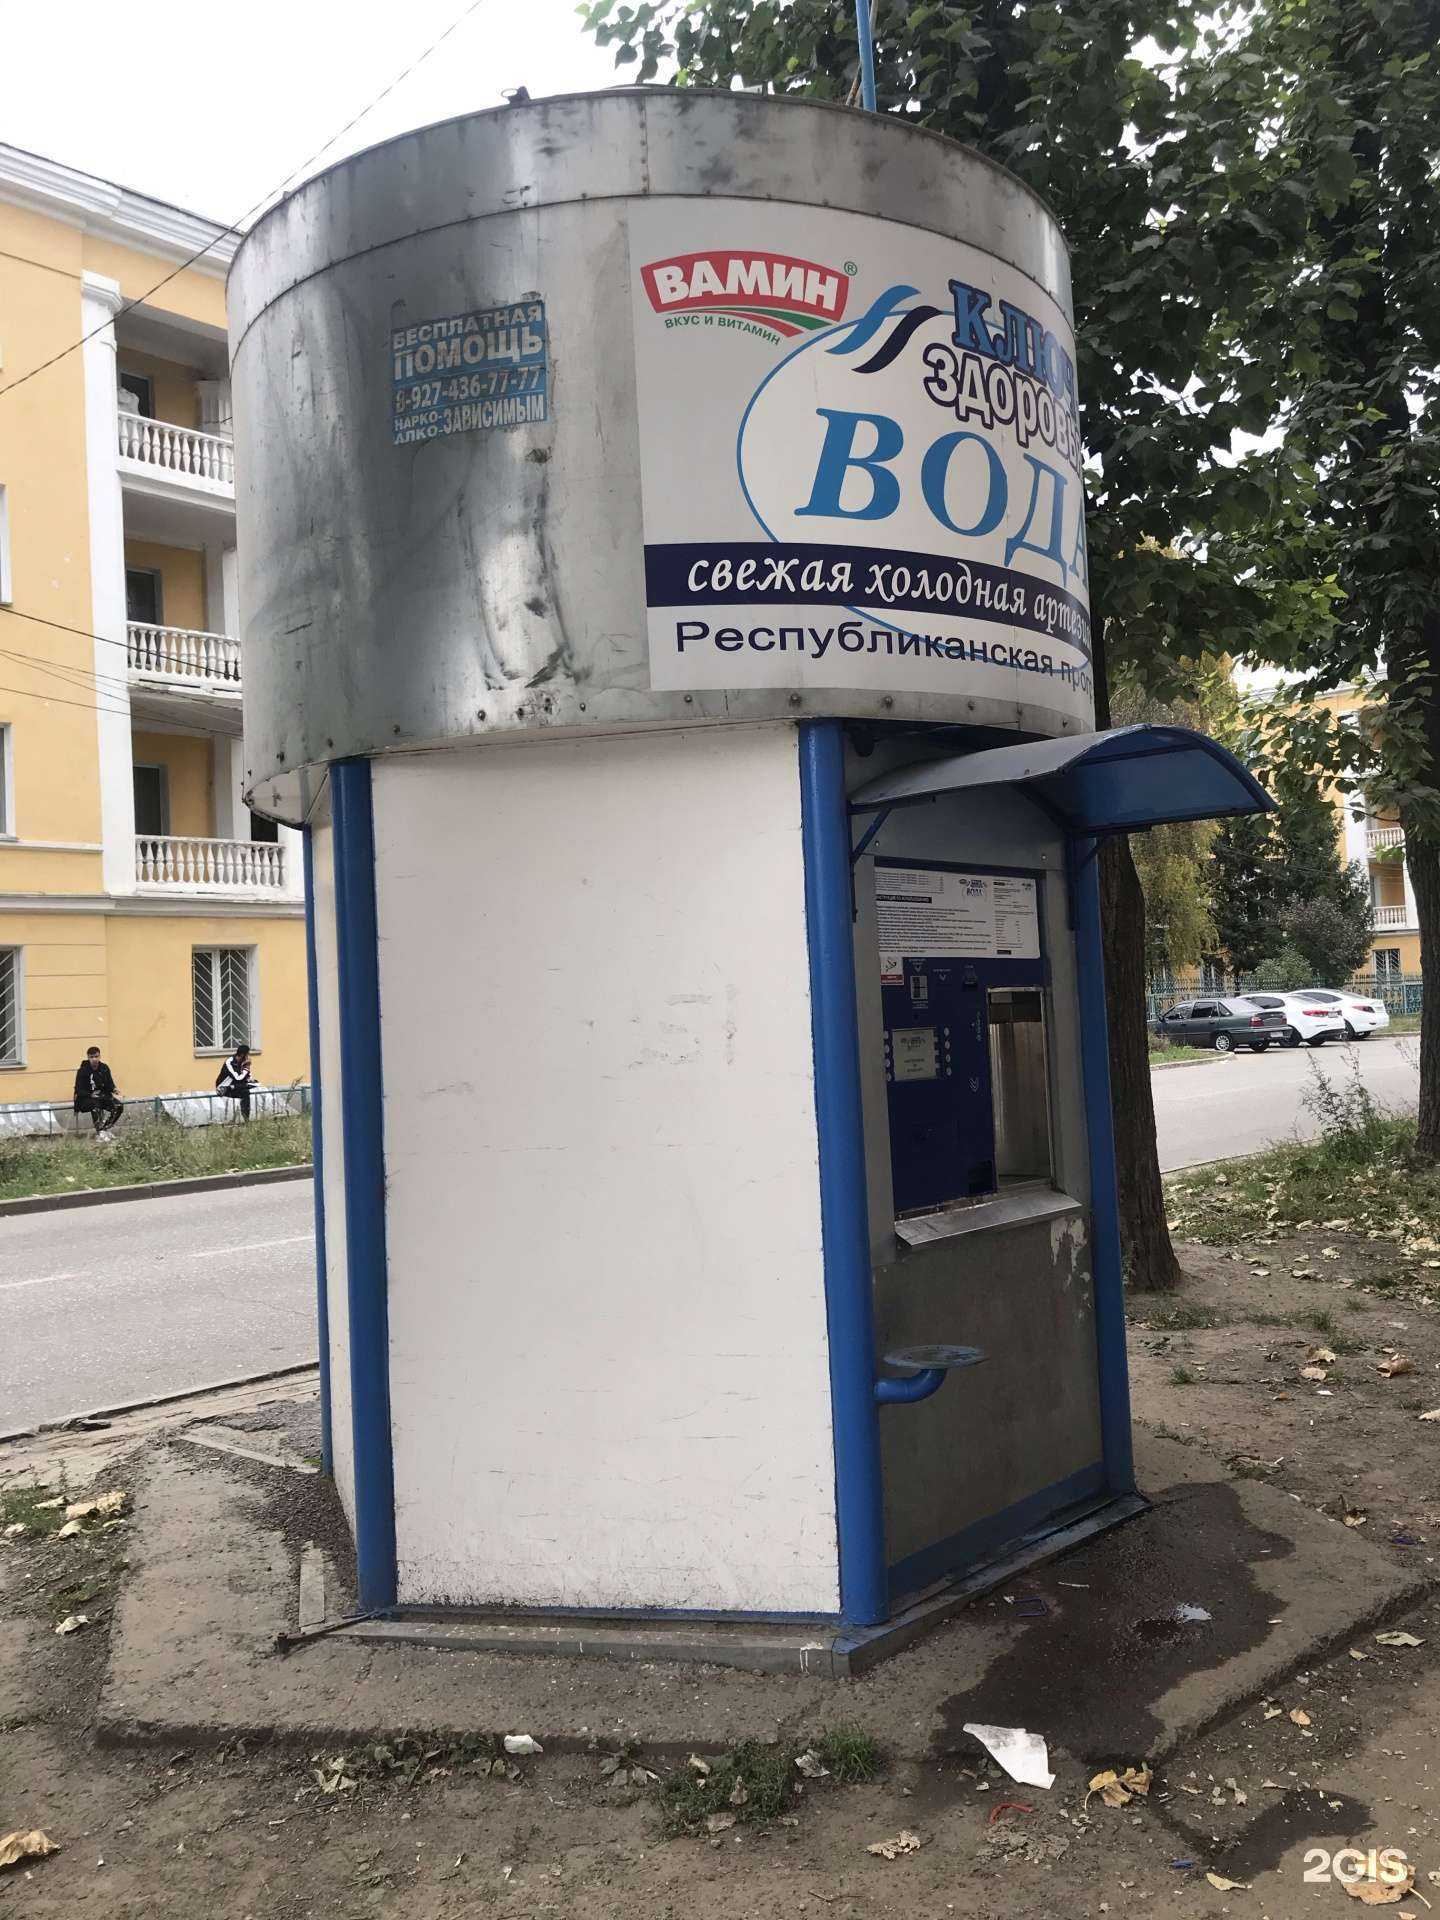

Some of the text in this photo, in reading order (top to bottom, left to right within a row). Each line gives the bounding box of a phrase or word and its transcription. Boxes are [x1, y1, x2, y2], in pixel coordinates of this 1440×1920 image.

[653, 259, 839, 311] ВАМИН
[393, 305, 542, 350] БЕСПЛАТНАЯ
[394, 327, 543, 381] ПОМОЩЬ
[665, 315, 781, 346] ВКУС И ВИТАМИН
[395, 366, 542, 414] 8-927-436-77-77
[794, 408, 1089, 590] ВОДА
[688, 557, 853, 593] свежая
[865, 562, 1027, 616] холодная
[676, 621, 1053, 677] Республиканская
